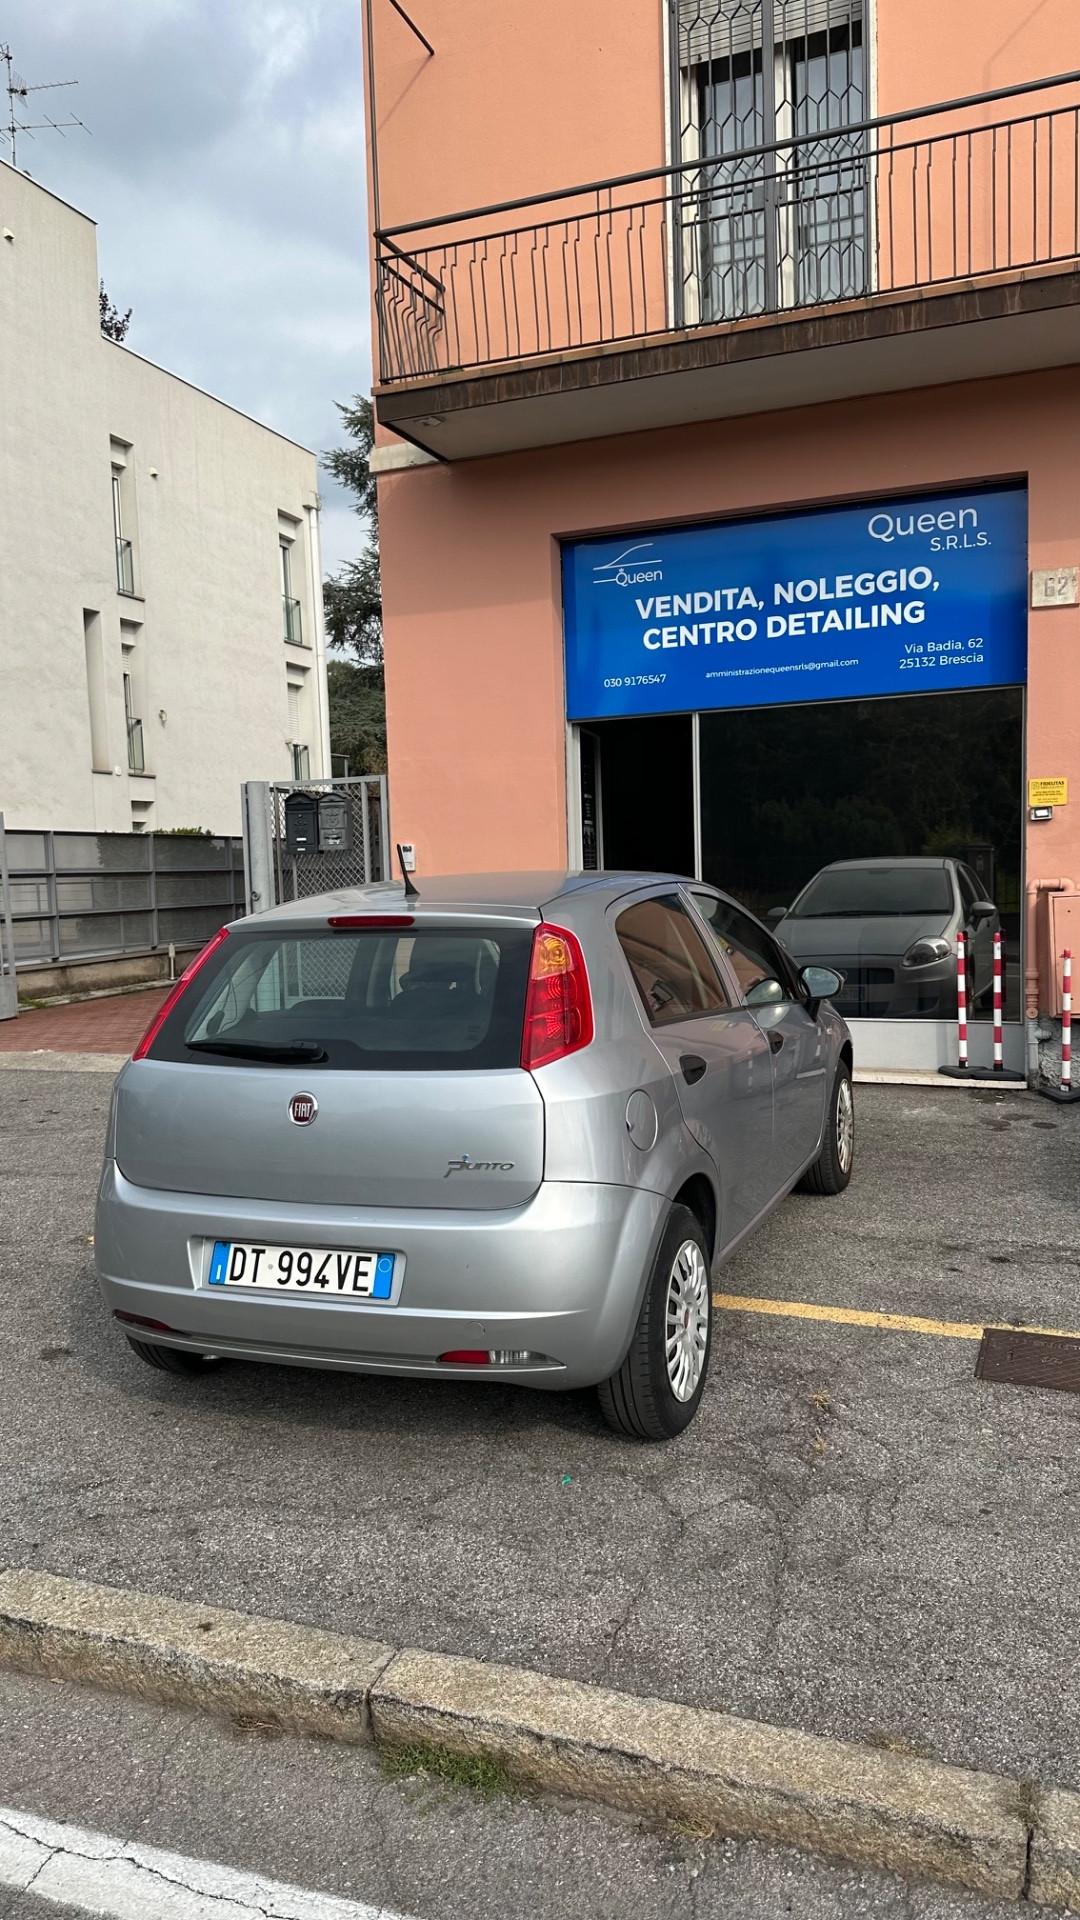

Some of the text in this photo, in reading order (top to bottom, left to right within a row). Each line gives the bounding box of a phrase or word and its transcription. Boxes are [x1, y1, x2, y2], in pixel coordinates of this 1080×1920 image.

[868, 507, 978, 542] Queen
[930, 531, 992, 551] S.R.L.S.
[615, 570, 663, 587] Queen
[635, 566, 940, 620] VENDITA, NOLEGGIO,
[643, 600, 926, 650] CENTRO DETAILING
[905, 637, 984, 654] Via Badia, 62
[705, 658, 859, 679] amministrazionequeensrls@gmail.com
[899, 652, 984, 669] 25132 Brescia
[604, 673, 667, 688] 030 9176547
[295, 1102, 312, 1117] FIAT
